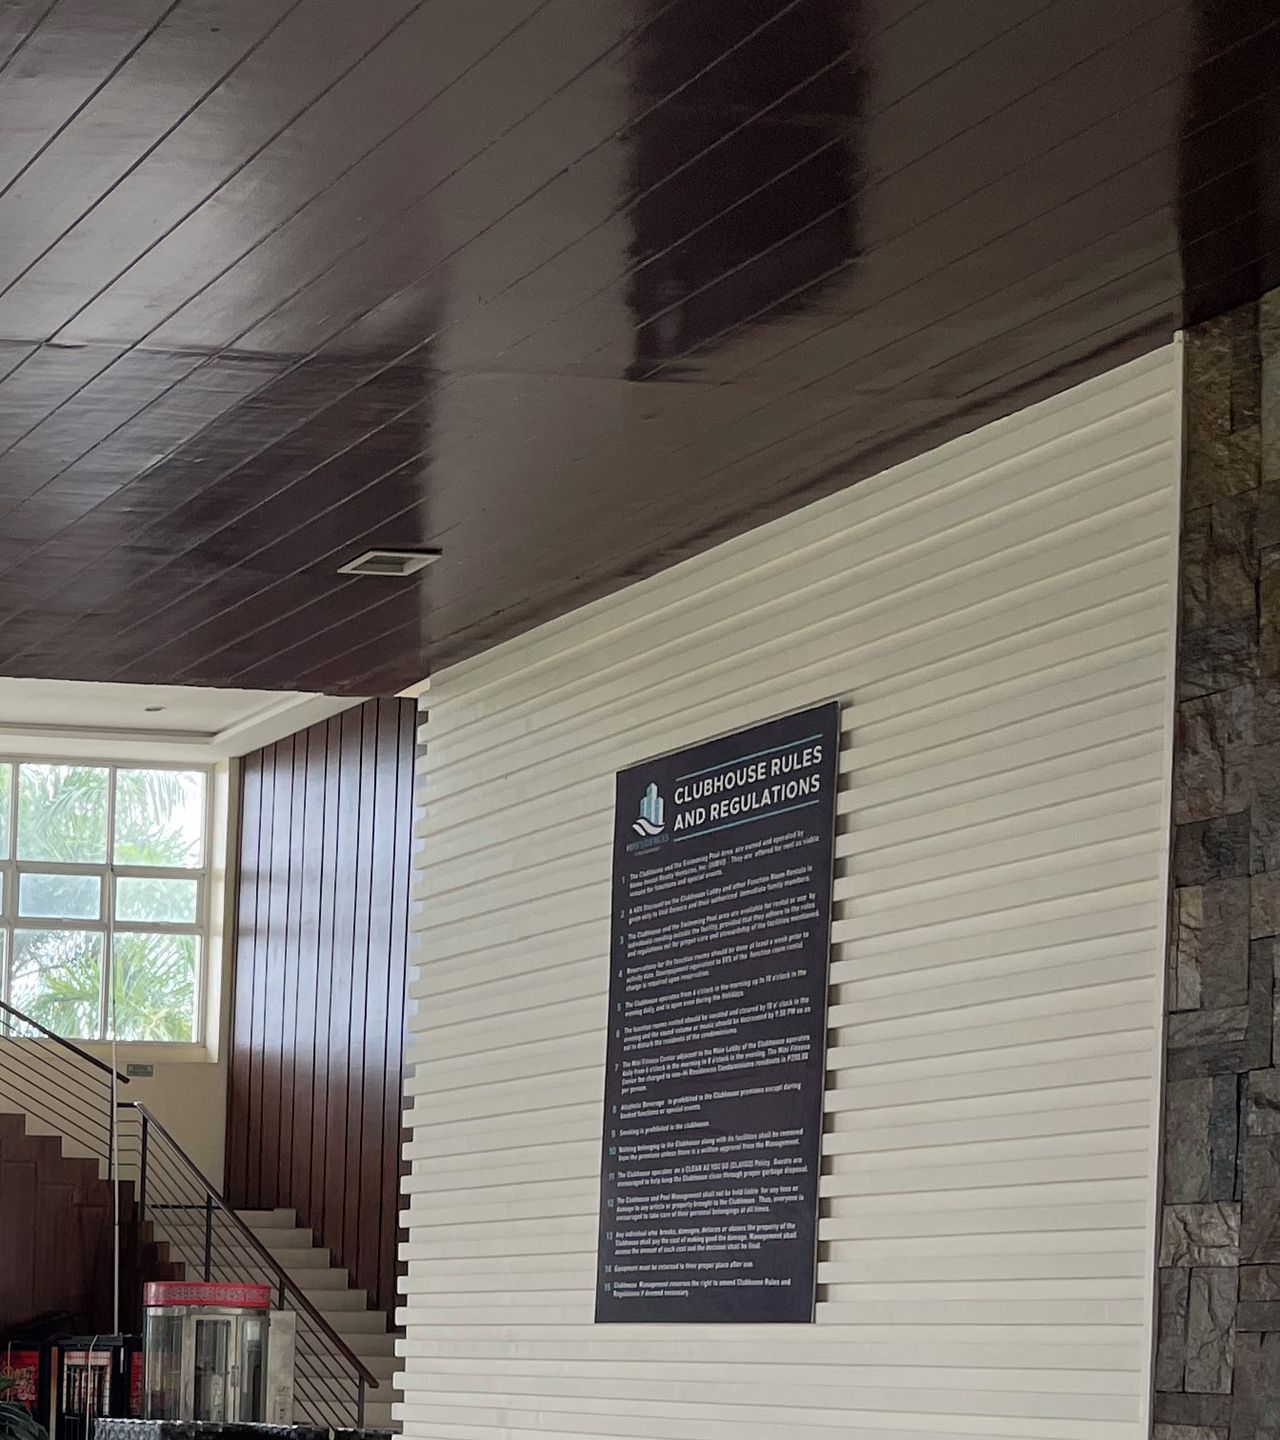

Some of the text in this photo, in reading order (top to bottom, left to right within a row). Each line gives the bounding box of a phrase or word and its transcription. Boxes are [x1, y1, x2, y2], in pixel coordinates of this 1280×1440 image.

[673, 773, 821, 832] AND REGULATIONS
[674, 745, 823, 805] CLUBHOUSE RULES
